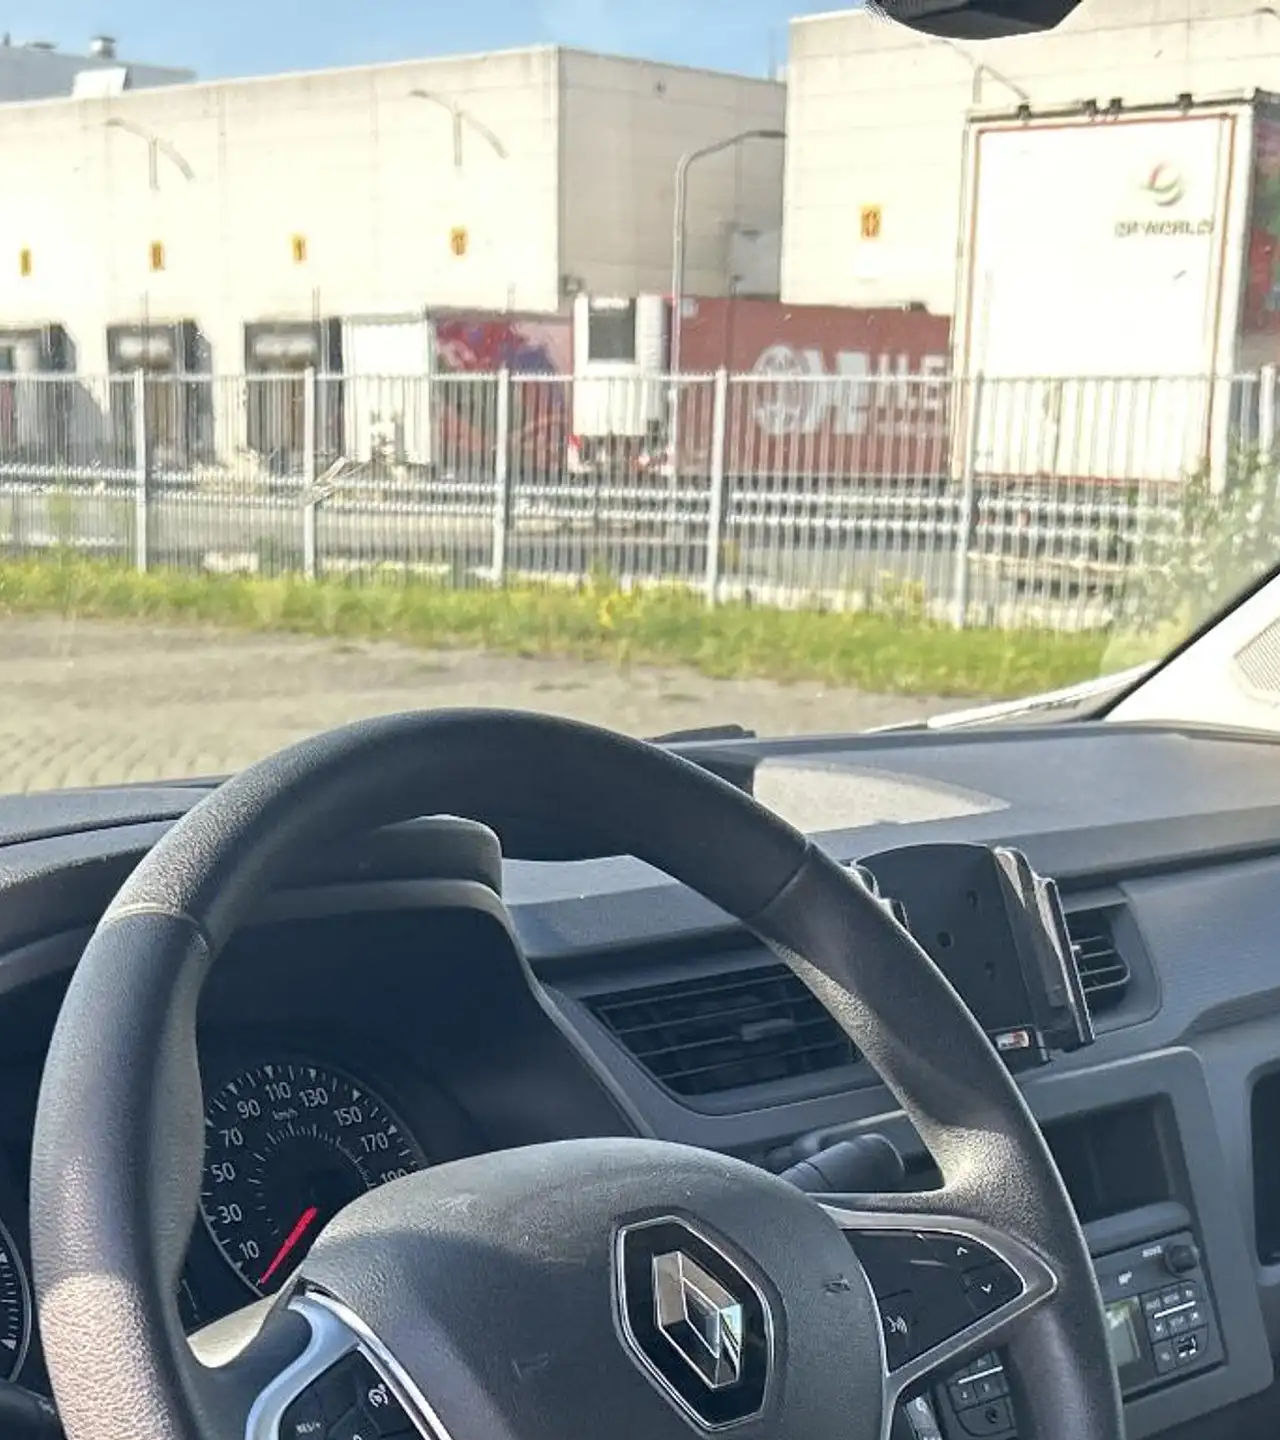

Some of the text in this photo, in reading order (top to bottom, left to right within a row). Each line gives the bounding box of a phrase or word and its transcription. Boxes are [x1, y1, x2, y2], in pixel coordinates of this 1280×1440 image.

[265, 1081, 292, 1101] 110
[299, 1087, 329, 1108] 130
[237, 1098, 261, 1119] 90
[333, 1106, 363, 1127] 150
[219, 1126, 244, 1147] 70
[361, 1132, 389, 1152] 170
[210, 1161, 236, 1183] 50
[220, 1203, 242, 1224] 30
[238, 1240, 260, 1260] 10
